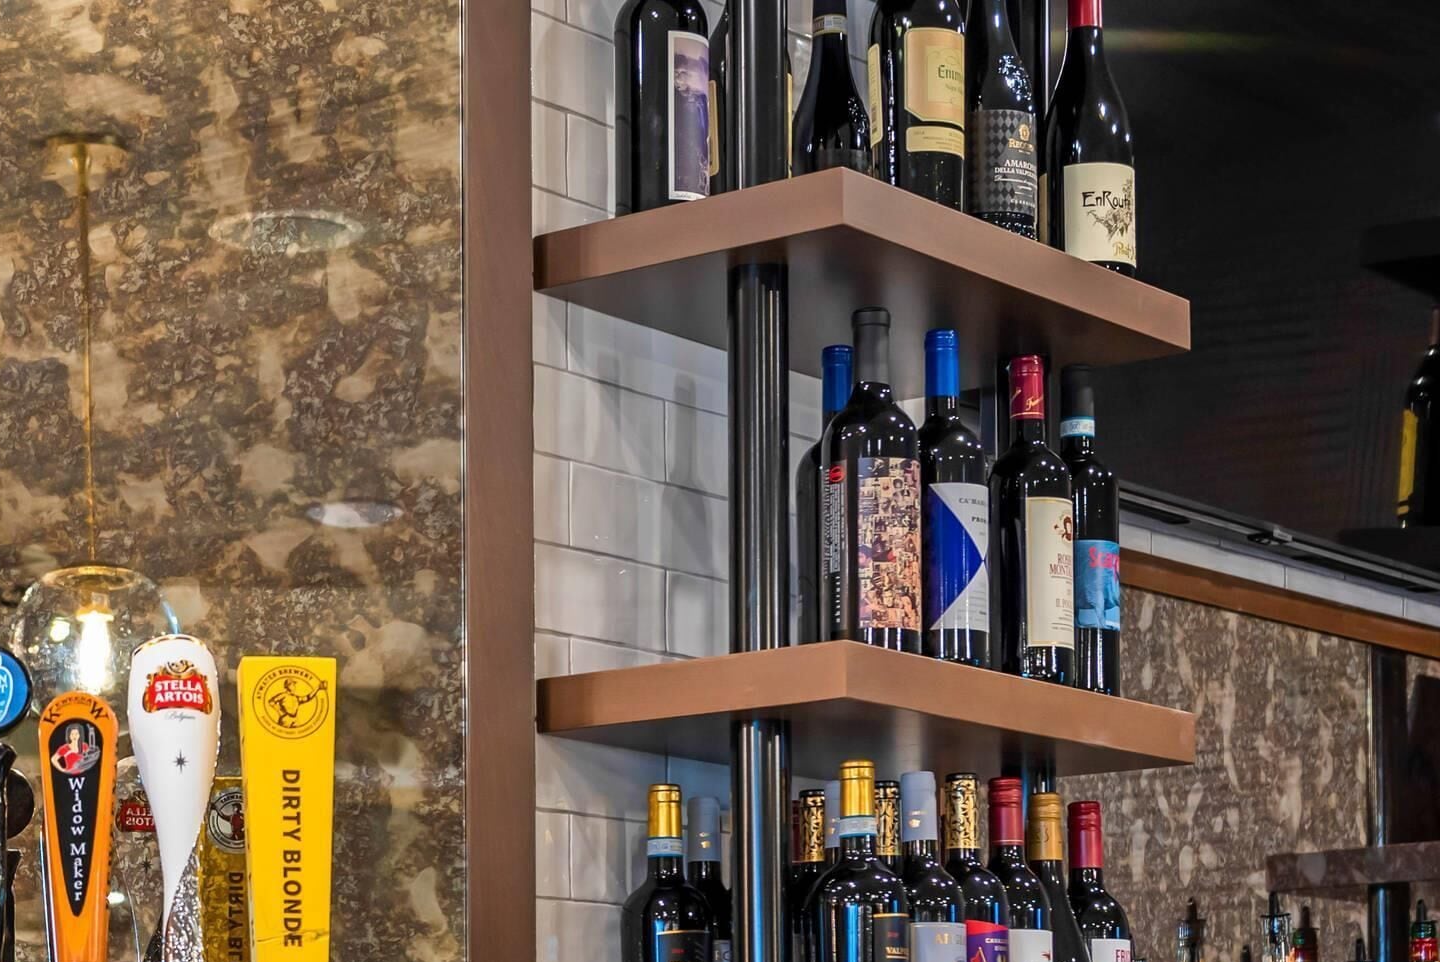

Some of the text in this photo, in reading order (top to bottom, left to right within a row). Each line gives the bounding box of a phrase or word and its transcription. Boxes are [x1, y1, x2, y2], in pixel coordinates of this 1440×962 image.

[154, 679, 203, 693] STELLA
[154, 690, 204, 705] ARTOIS
[68, 777, 87, 901] Widow Maker
[282, 769, 302, 947] DIRTY BLONDE
